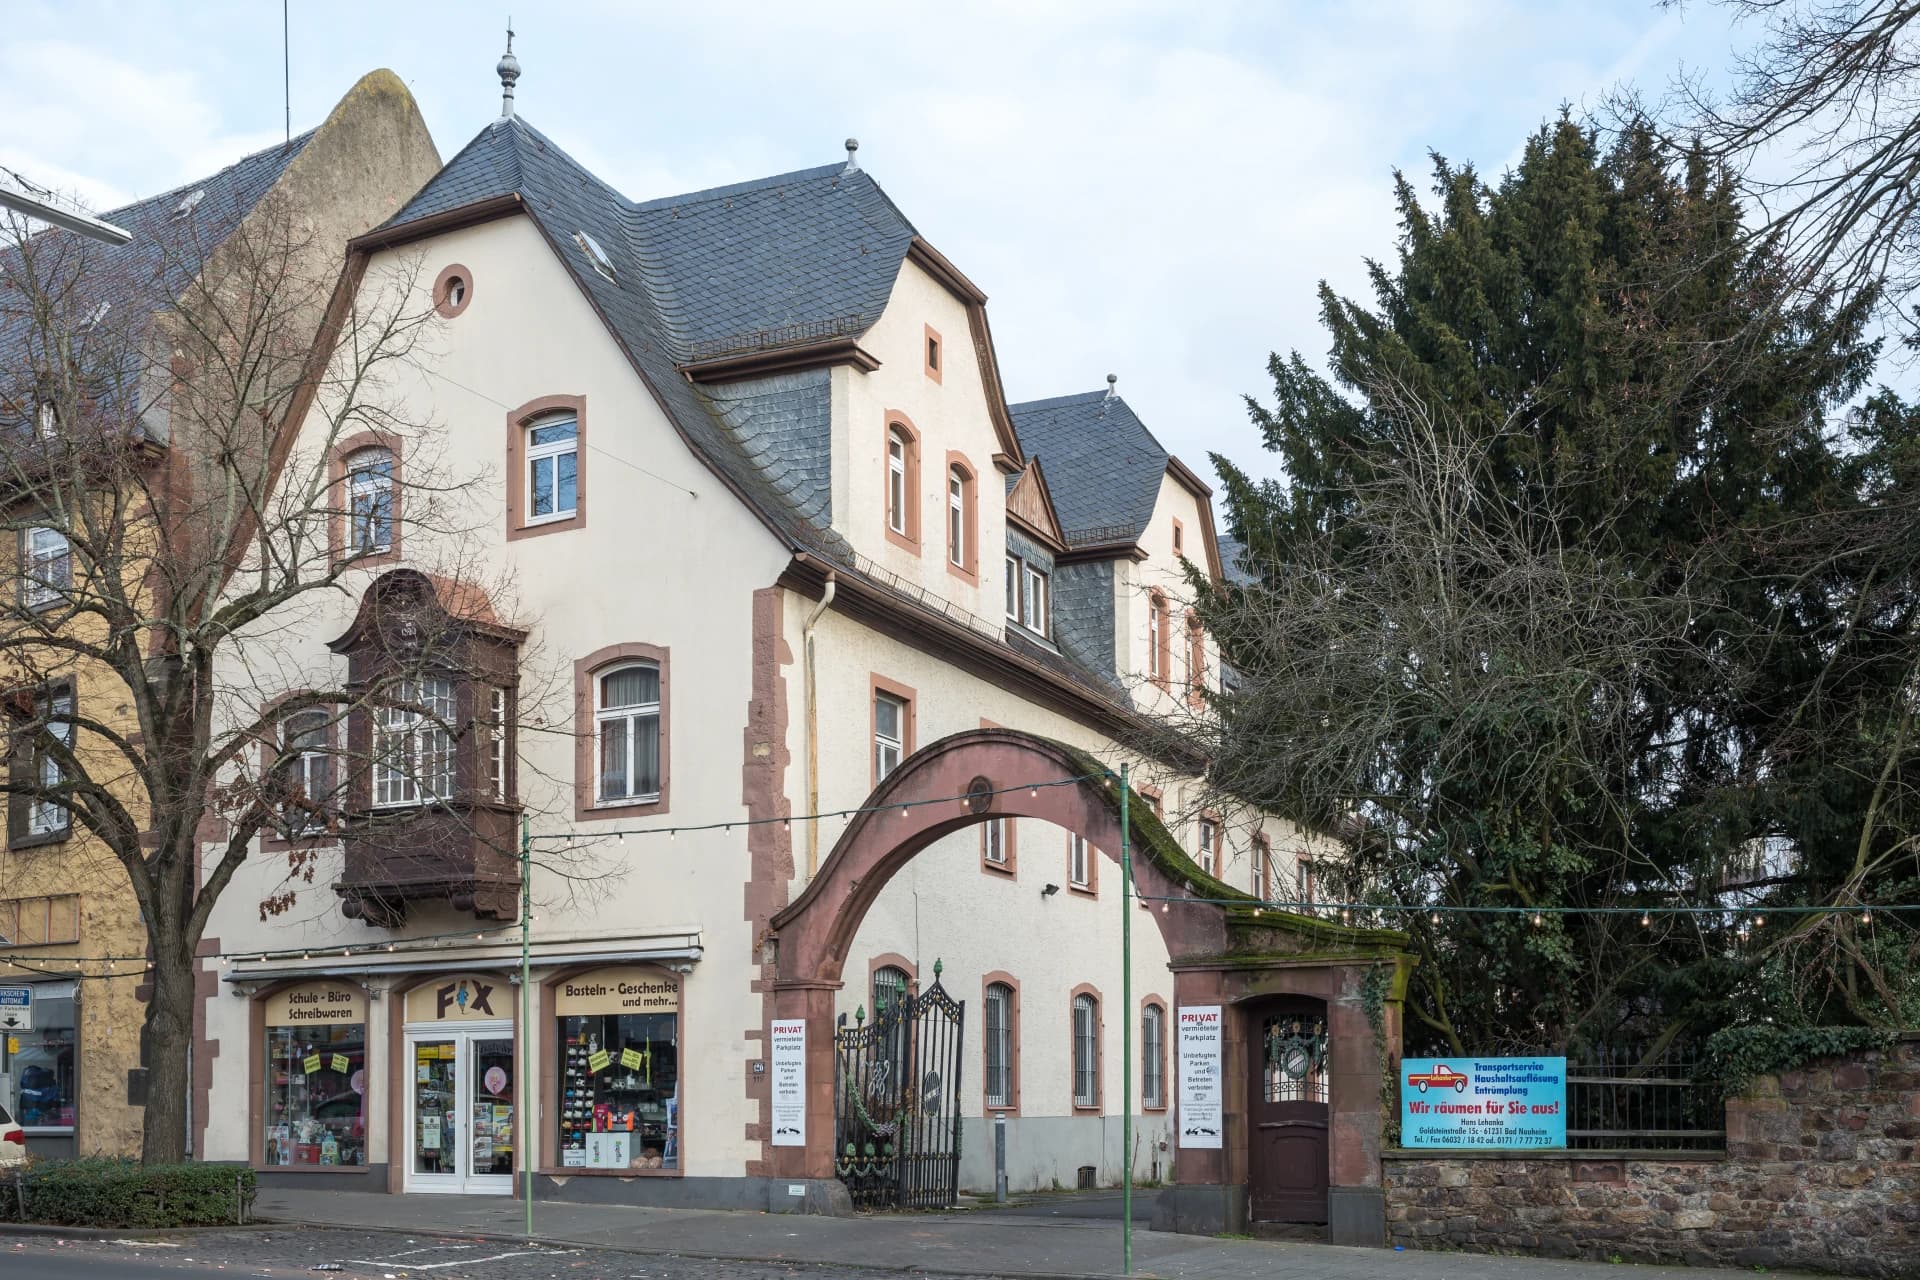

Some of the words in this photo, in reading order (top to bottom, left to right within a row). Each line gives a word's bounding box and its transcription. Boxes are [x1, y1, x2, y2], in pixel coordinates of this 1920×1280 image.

[565, 984, 607, 997] Basteln
[618, 981, 678, 995] Geschenke
[289, 992, 319, 1004] Schule
[328, 991, 352, 1003] Büro
[622, 997, 640, 1007] und
[643, 996, 678, 1006] mehr...
[289, 1008, 352, 1020] Schreibwaren
[1181, 1014, 1218, 1022] PRIVAT
[774, 1026, 802, 1034] PRIVAT
[1184, 1034, 1216, 1042] Parkplatz
[1474, 1062, 1544, 1072] Transportservice
[1474, 1073, 1559, 1085] Haushaltsauflösung
[1474, 1086, 1529, 1096] Entrümplung
[1409, 1101, 1431, 1114] Wir
[1434, 1101, 1482, 1114] räumen
[1485, 1100, 1505, 1114] für
[1508, 1101, 1528, 1114] Sie
[1531, 1101, 1559, 1114] aus!
[1461, 1118, 1476, 1126] Hans
[1478, 1117, 1504, 1126] Lehanka
[1419, 1126, 1467, 1135] Goldsteinstraße
[1469, 1127, 1479, 1135] 15c
[1484, 1127, 1502, 1135] 61231
[1504, 1127, 1517, 1135] Bad
[1518, 1127, 1547, 1135] Nauheim
[1442, 1136, 1461, 1144] 06032
[1467, 1136, 1475, 1144] 18
[1476, 1136, 1485, 1144] 42
[1497, 1136, 1512, 1144] 0171
[1534, 1137, 1543, 1145] 72
[1544, 1137, 1552, 1145] 37
